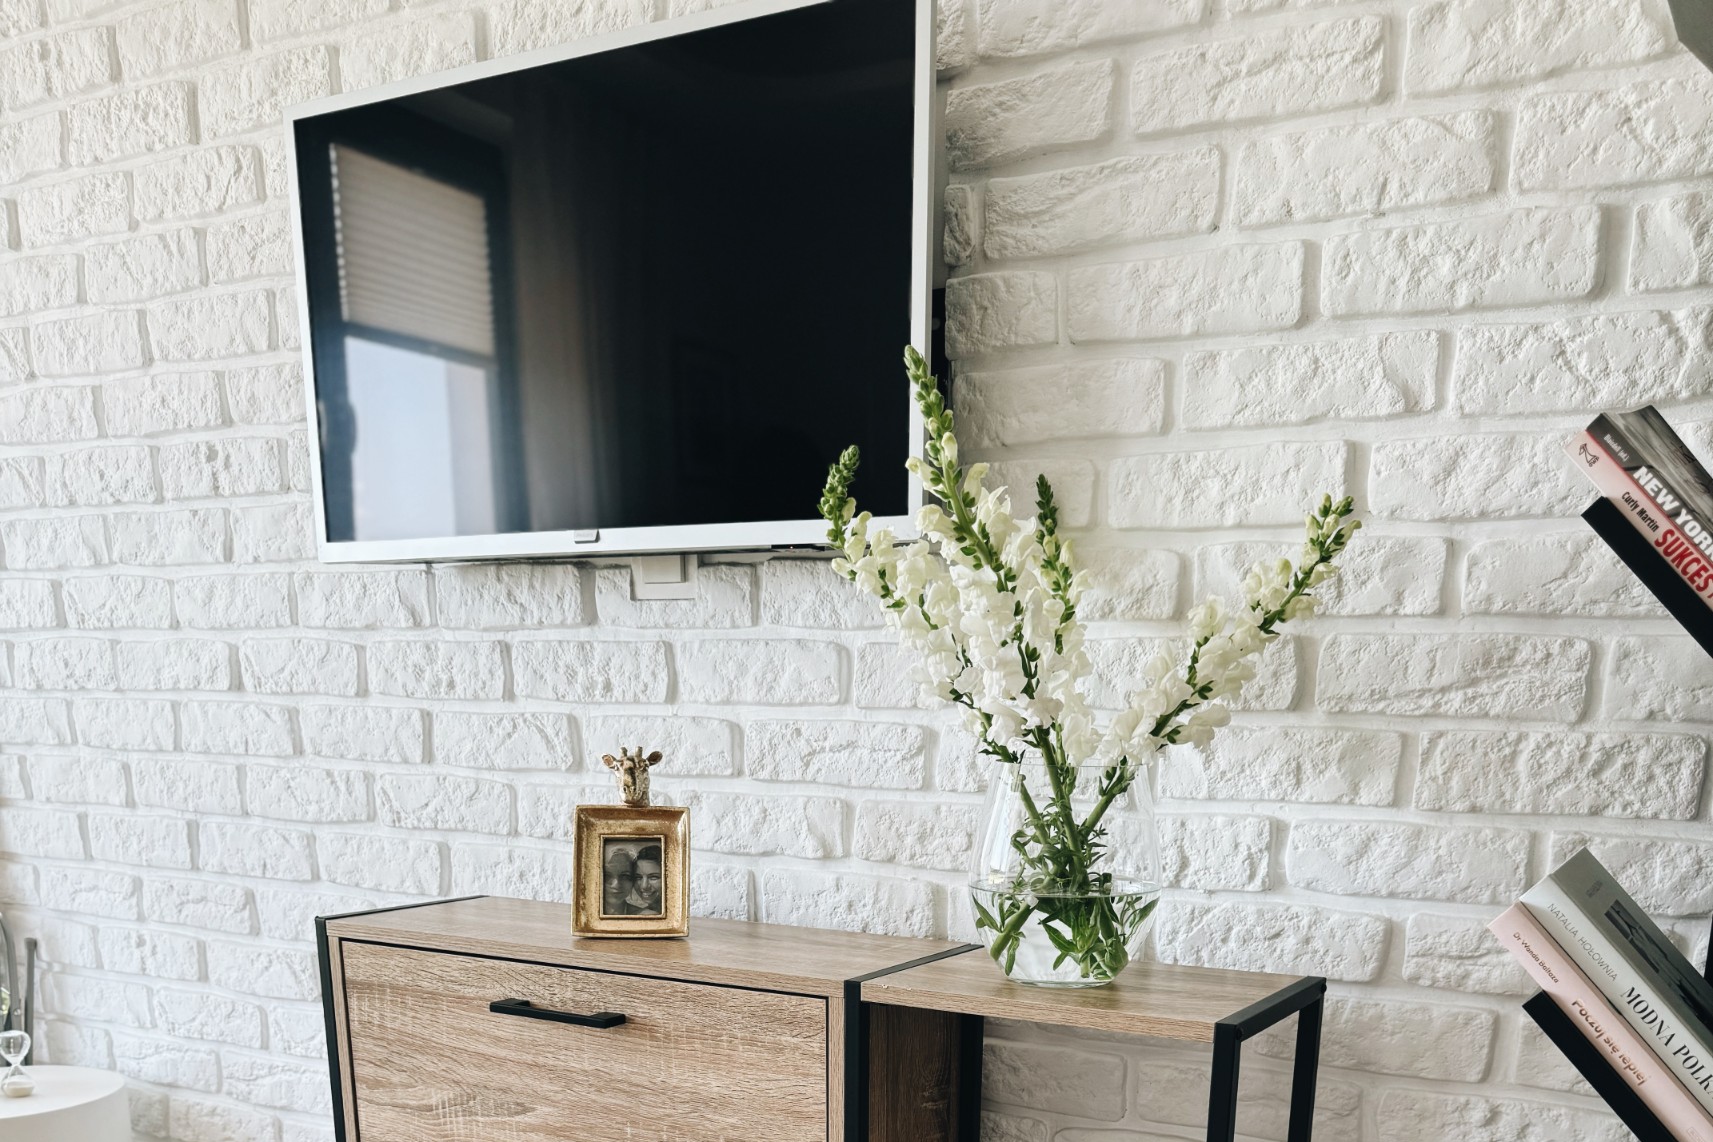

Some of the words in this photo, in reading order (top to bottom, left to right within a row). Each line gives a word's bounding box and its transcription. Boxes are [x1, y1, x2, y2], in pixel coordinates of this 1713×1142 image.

[1621, 491, 1640, 513] Curly
[1637, 507, 1660, 533] Martin
[1633, 465, 1680, 511] NEW
[1654, 528, 1713, 592] SUKCES
[1512, 931, 1522, 942] Dr
[1519, 938, 1541, 964] Wanda
[1547, 903, 1578, 939] NATALIA
[1577, 935, 1619, 983] HOŁOWNIA
[1571, 998, 1604, 1041] Poczuj
[1603, 1035, 1620, 1056] się
[1619, 986, 1675, 1048] MODNA
[1672, 1044, 1713, 1099] POLK
